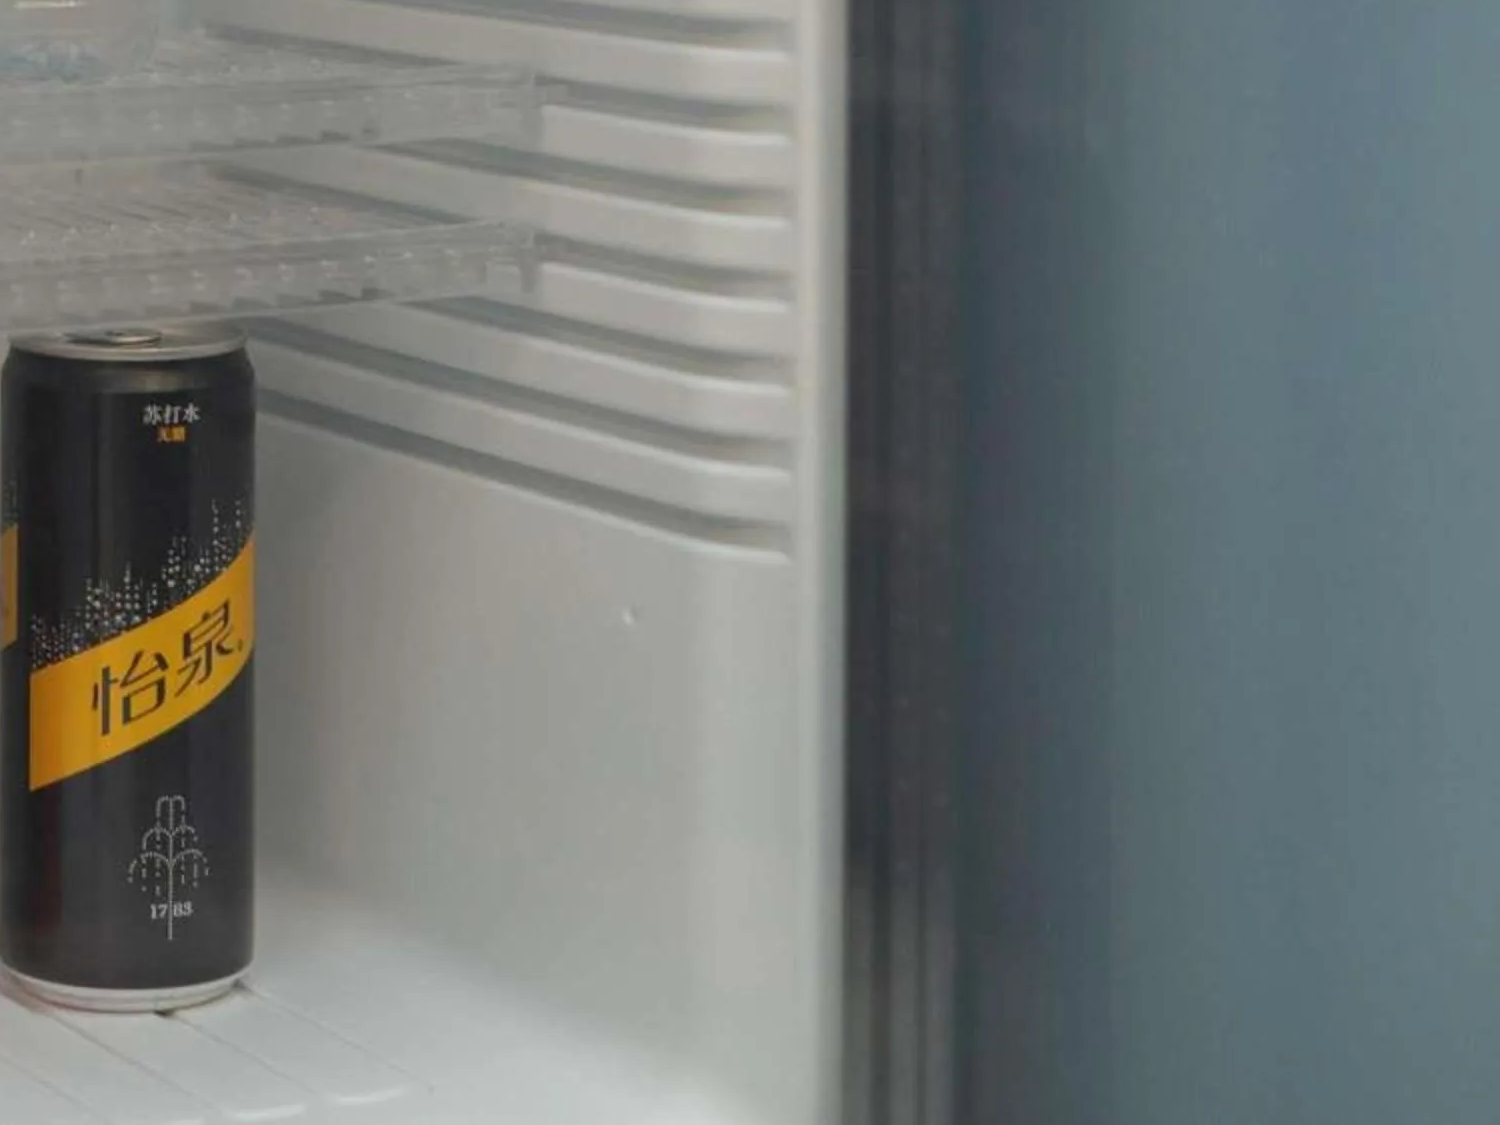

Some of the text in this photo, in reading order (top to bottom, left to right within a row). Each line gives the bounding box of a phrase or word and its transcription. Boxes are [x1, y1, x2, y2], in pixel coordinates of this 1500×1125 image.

[142, 402, 201, 425] 苏打水
[92, 599, 233, 736] 怡泉
